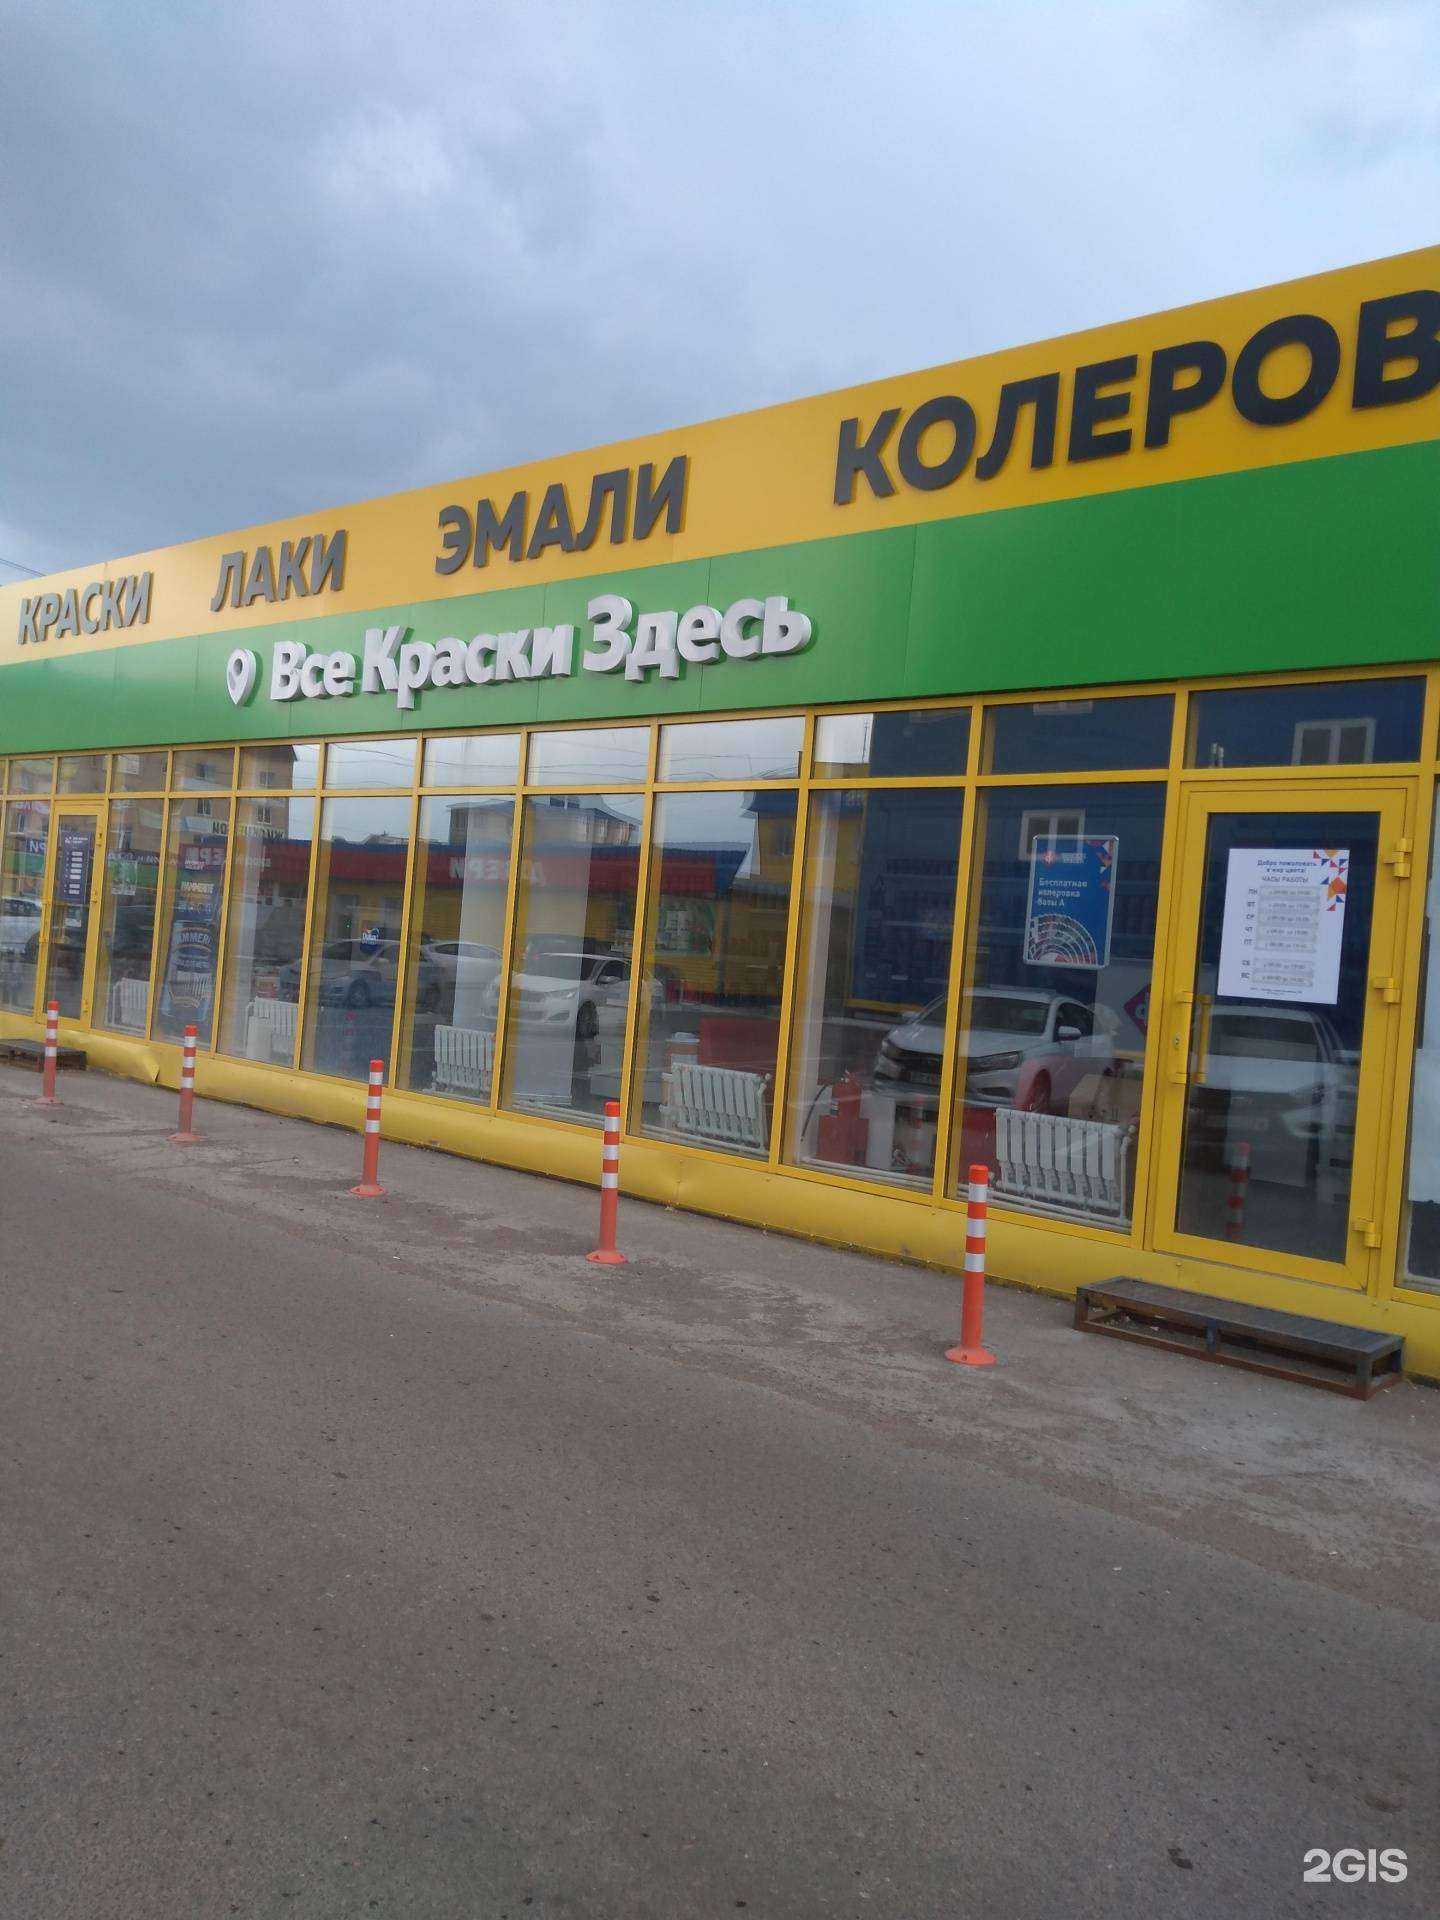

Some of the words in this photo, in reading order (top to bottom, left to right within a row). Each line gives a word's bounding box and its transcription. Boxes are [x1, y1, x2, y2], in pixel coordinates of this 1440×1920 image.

[833, 288, 1440, 505] КОЛЕРОВ
[435, 455, 690, 575] ЭМАЛИ
[17, 571, 153, 645] КРАСКИ
[210, 529, 347, 612] ЛАКИ
[582, 594, 814, 684] Здесь
